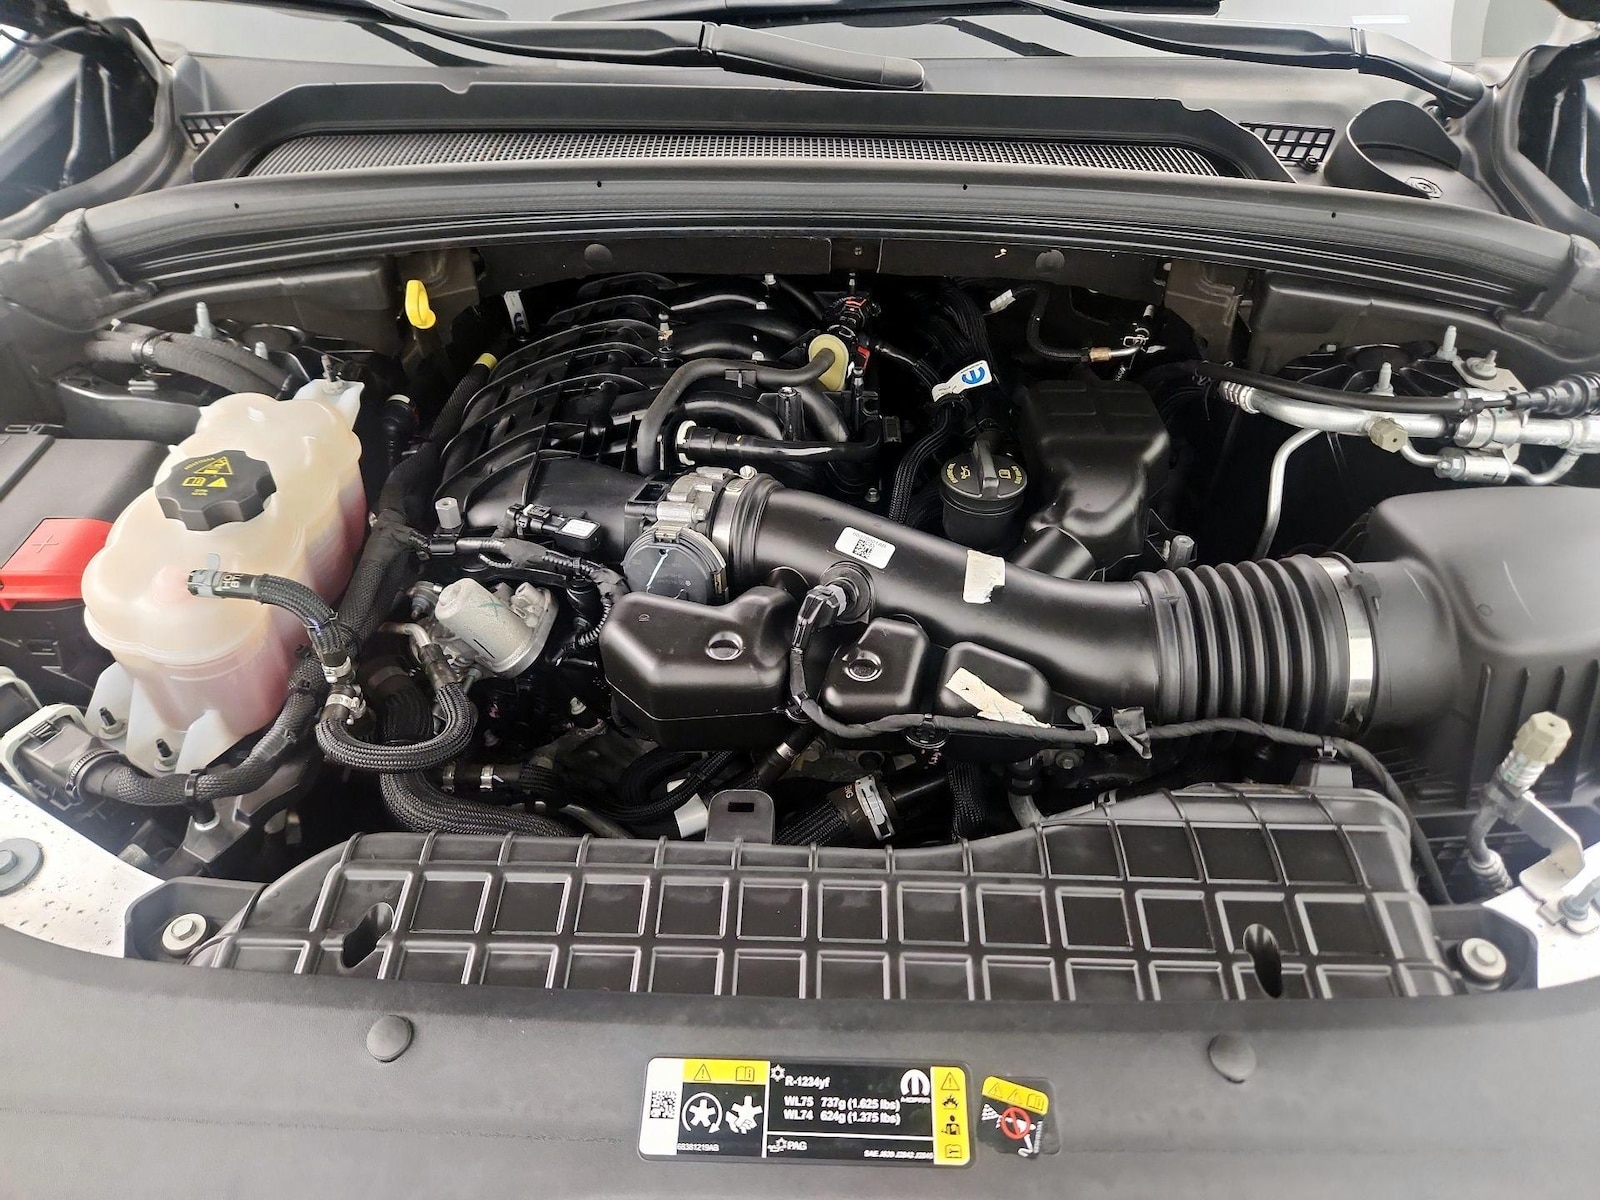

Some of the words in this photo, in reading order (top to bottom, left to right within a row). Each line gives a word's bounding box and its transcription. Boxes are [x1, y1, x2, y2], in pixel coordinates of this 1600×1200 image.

[221, 574, 233, 590] HO
[784, 1075, 831, 1090] R-1234yf
[784, 1095, 814, 1107] WL75
[820, 1096, 846, 1110] 737g
[847, 1097, 879, 1111] (1.625
[879, 1098, 901, 1112] lbs)
[783, 1109, 814, 1120] WL74
[820, 1110, 846, 1124] 624g
[847, 1111, 880, 1124] (1.375
[879, 1112, 901, 1126] lbs)
[787, 1141, 808, 1151] PAG
